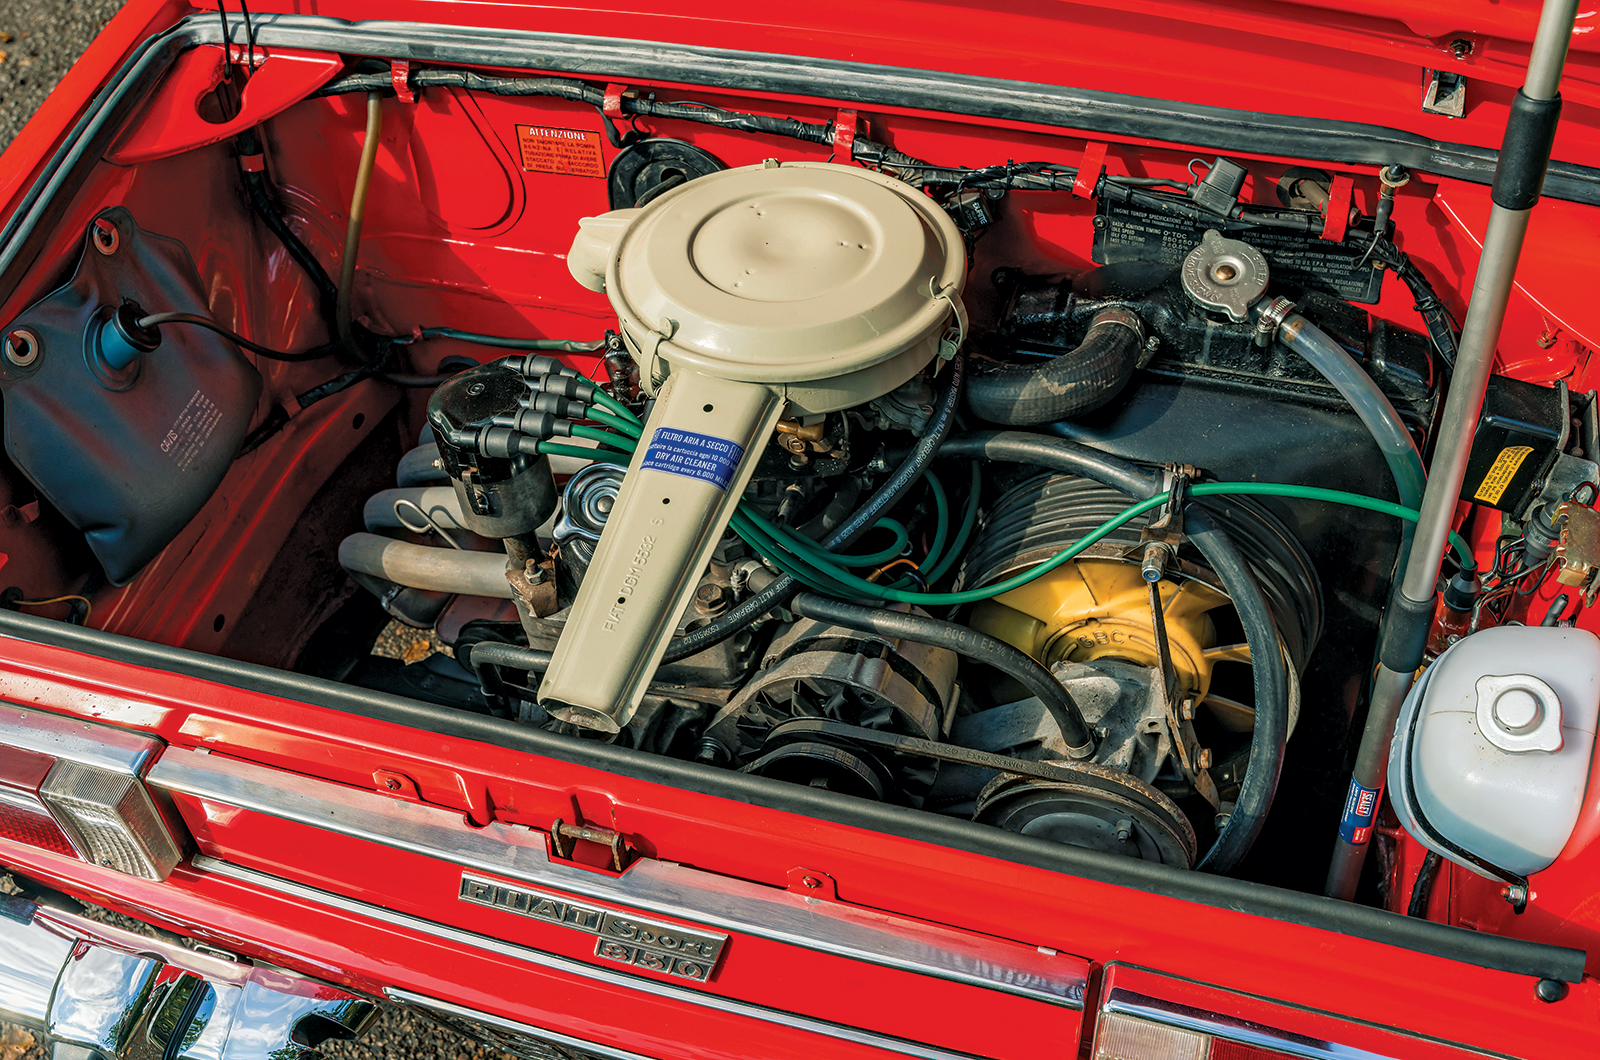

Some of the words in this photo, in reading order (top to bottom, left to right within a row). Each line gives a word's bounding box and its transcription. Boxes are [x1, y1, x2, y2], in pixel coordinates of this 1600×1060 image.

[530, 128, 586, 140] ATTENZIONE
[1148, 214, 1181, 224] SPECIFICATIONS
[948, 386, 957, 406] MASTER
[160, 429, 178, 451] CAVIS
[660, 431, 682, 442] FILTRO
[683, 435, 698, 444] ARIA
[706, 440, 728, 452] SECCO
[655, 451, 669, 460] DRY
[670, 454, 682, 463] AIR
[683, 457, 716, 470] CLEANER
[672, 446, 698, 456] cartuccia
[698, 452, 710, 460] ogni
[711, 455, 729, 464] 10.000
[914, 440, 935, 466] CARBURANT
[696, 470, 714, 478] 6.000
[853, 513, 869, 526] GATES
[604, 604, 622, 631] FIAT
[620, 567, 641, 594] DGM
[633, 536, 655, 564] 5532
[728, 601, 756, 622] CARBURANTE
[944, 628, 966, 642] 806
[1358, 792, 1372, 813] SEALEY
[467, 880, 598, 926] FIAT
[608, 920, 714, 957] Sport
[603, 943, 704, 978] 850
